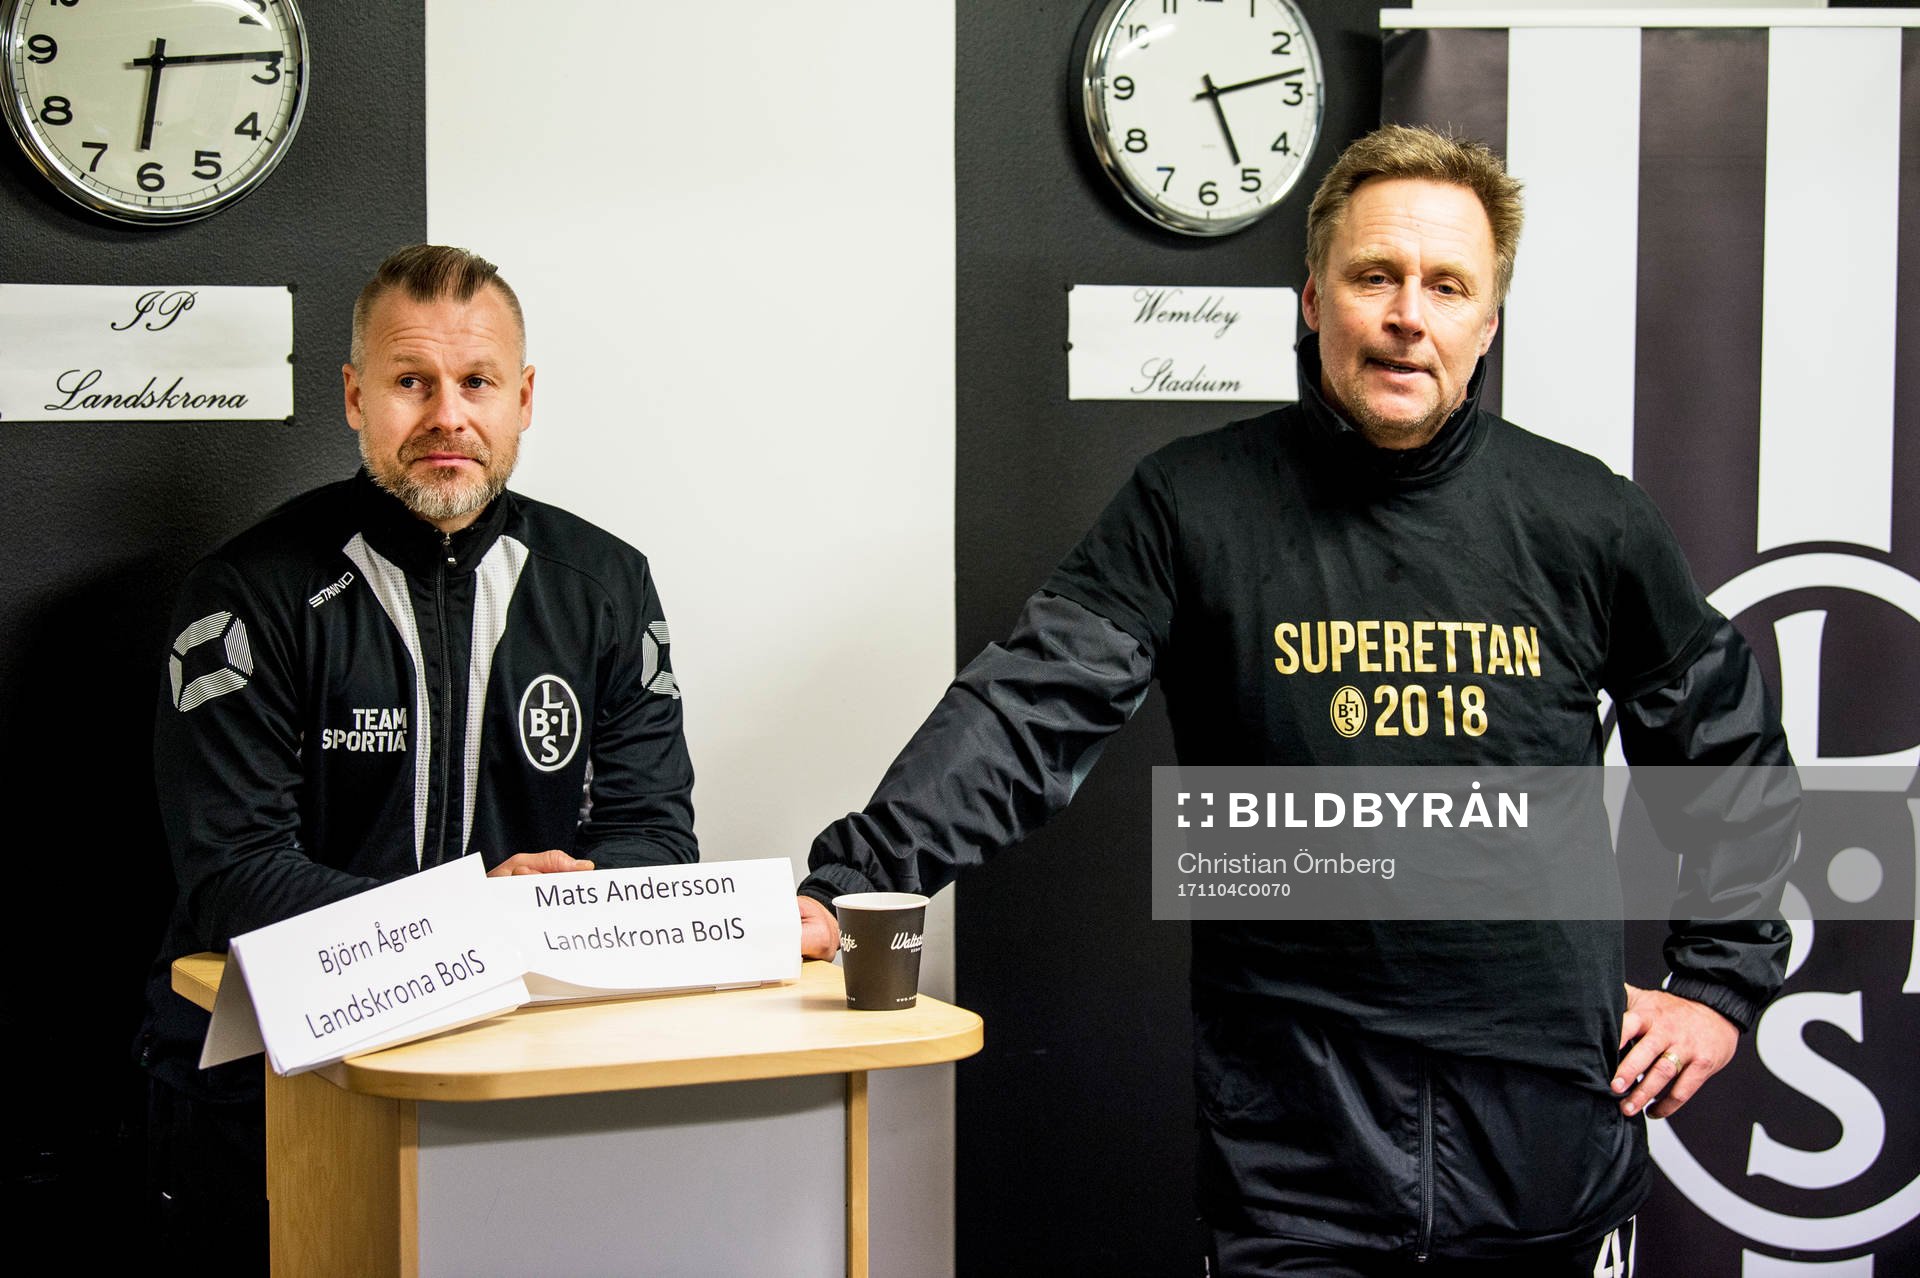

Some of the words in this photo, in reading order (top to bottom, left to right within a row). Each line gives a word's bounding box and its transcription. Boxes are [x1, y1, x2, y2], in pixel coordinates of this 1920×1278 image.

[27, 34, 58, 65] 9
[1271, 31, 1292, 55] 2
[1113, 76, 1135, 100] 9
[1282, 82, 1304, 106] 3
[40, 96, 73, 126] 8
[234, 111, 262, 141] 4
[1125, 129, 1148, 153] 8
[1270, 131, 1291, 156] 4
[81, 141, 109, 172] 7
[192, 150, 223, 181] 5
[137, 162, 165, 192] 6
[1156, 167, 1176, 192] 7
[1240, 168, 1262, 193] 5
[1198, 181, 1219, 207] 6
[1133, 287, 1240, 339] Wembley
[44, 369, 248, 411] Landskrona
[1130, 357, 1242, 394] Stadium
[308, 571, 355, 608] STANNO
[1274, 620, 1542, 677] SUPERETTAN
[352, 707, 408, 730] TEAM
[1373, 684, 1489, 737] 2018
[321, 728, 408, 752] SPORTIA
[535, 884, 598, 907] Mats
[606, 876, 736, 902] Andersson
[318, 942, 373, 975] Björn
[374, 918, 433, 953] Ågren
[543, 925, 685, 951] Landskrona
[691, 917, 745, 943] BoIS
[839, 930, 858, 953] affe
[305, 974, 436, 1039] Landskrona
[435, 949, 486, 987] BoIS
[1746, 990, 1886, 1189] S
